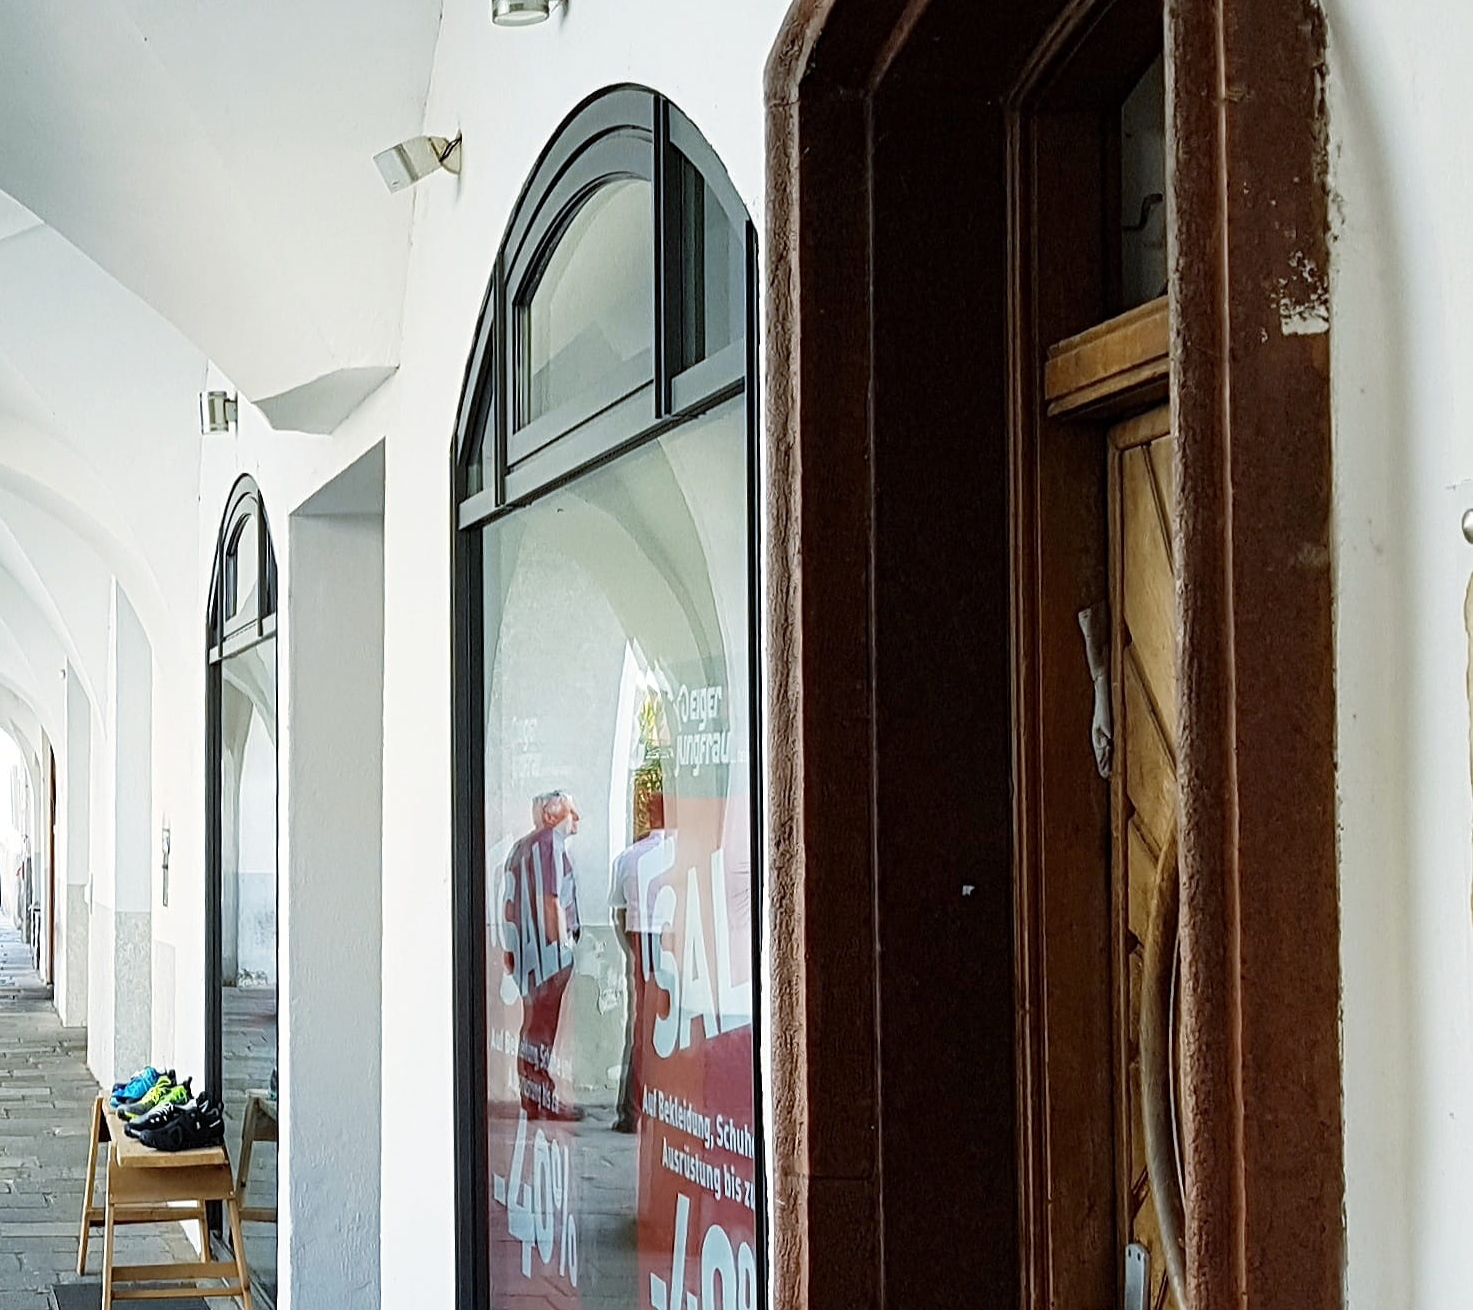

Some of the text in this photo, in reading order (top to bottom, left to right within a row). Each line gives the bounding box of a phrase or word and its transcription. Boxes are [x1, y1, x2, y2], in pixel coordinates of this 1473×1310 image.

[642, 1082, 657, 1118] Auf
[658, 1089, 714, 1151] Bekleidung,
[494, 1108, 577, 1288] -40%
[662, 1136, 721, 1201] Ausrüstung
[723, 1163, 742, 1202] bis
